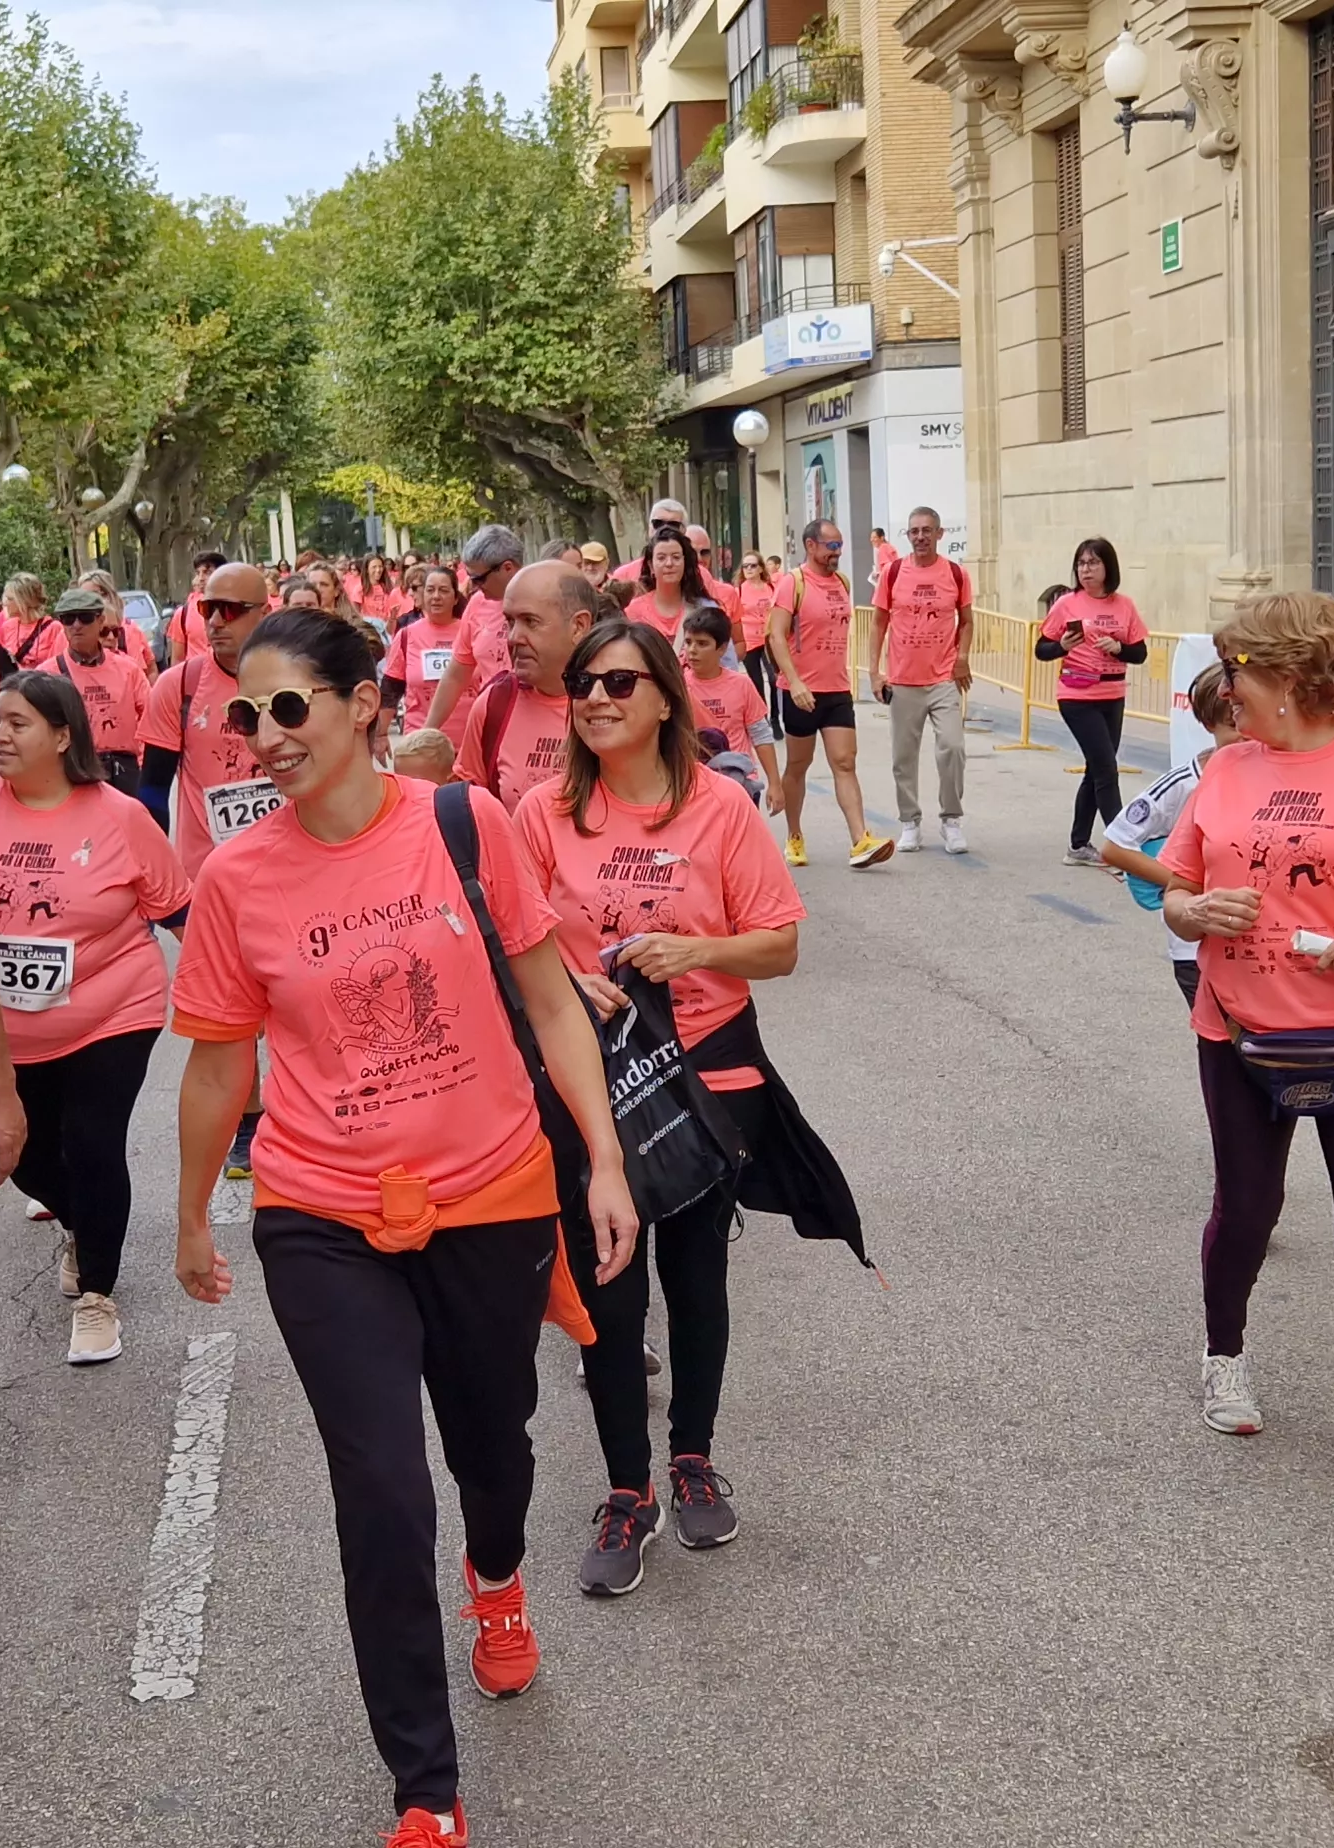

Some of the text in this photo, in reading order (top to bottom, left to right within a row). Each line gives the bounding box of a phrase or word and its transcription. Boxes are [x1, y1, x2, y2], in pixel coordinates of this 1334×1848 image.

[921, 424, 950, 436] SMY
[1268, 789, 1323, 807] CORRAMOS
[1251, 807, 1274, 821] POR
[1285, 806, 1325, 822] CIENCIA
[597, 862, 674, 884] POR LA CIENCIA
[309, 892, 425, 958] 9ª CÁNCER
[389, 905, 444, 933] HUESCA
[27, 950, 62, 961] CÁNCER
[360, 1043, 460, 1079] QUIÉRETE MUCHO
